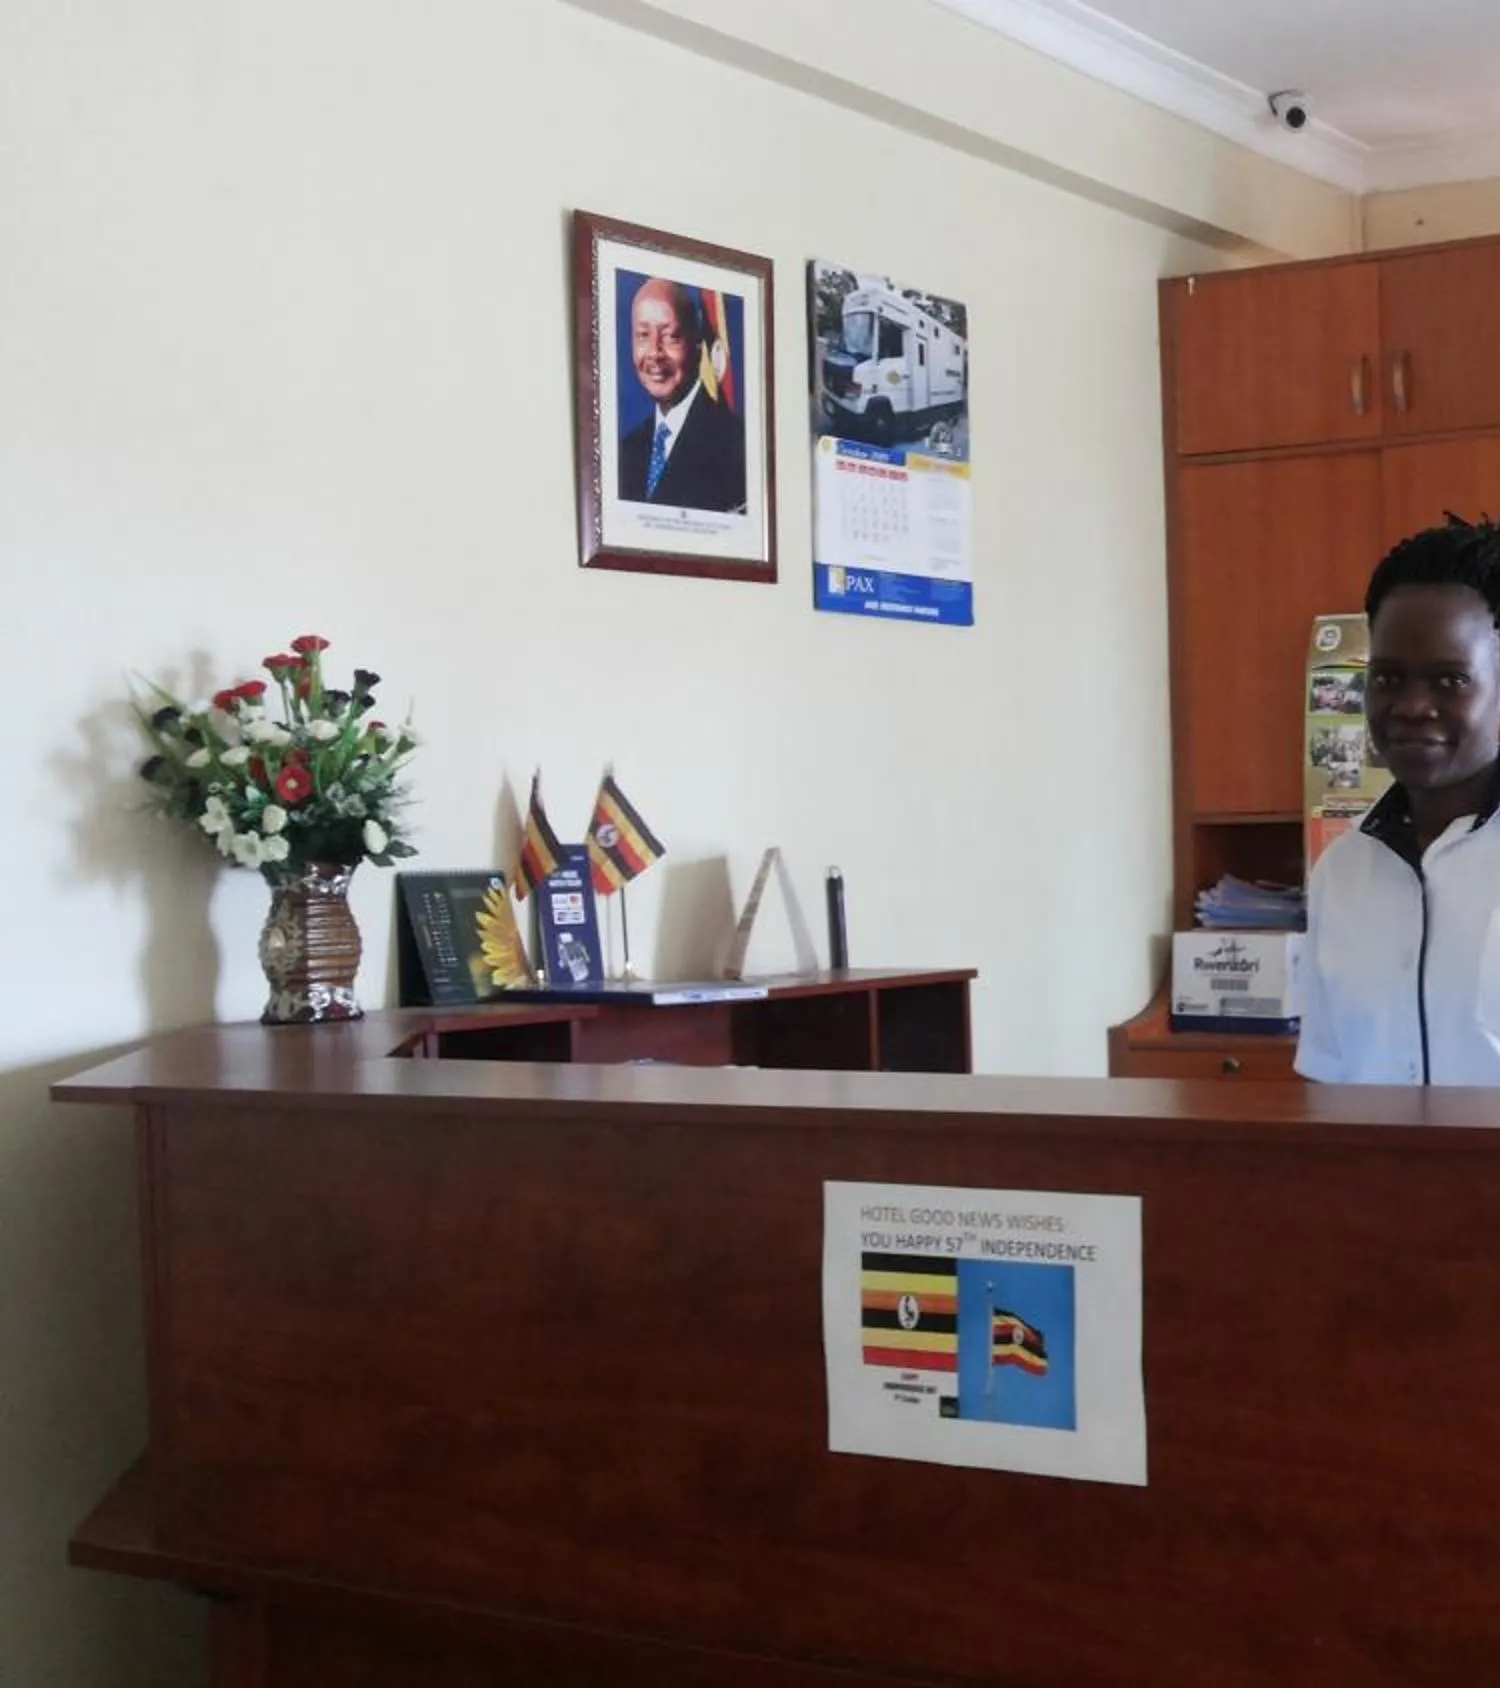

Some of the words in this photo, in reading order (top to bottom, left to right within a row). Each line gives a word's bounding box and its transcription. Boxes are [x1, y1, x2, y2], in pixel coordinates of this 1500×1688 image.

[846, 575, 875, 593] PAX
[861, 1205, 905, 1223] HOTEL
[909, 1207, 956, 1226] GOOD
[958, 1210, 1003, 1230] NEWS
[1007, 1214, 1065, 1233] WISHES
[861, 1231, 892, 1249] YOU
[895, 1234, 942, 1251] HAPPY
[981, 1240, 1098, 1262] INDEPENDENCE
